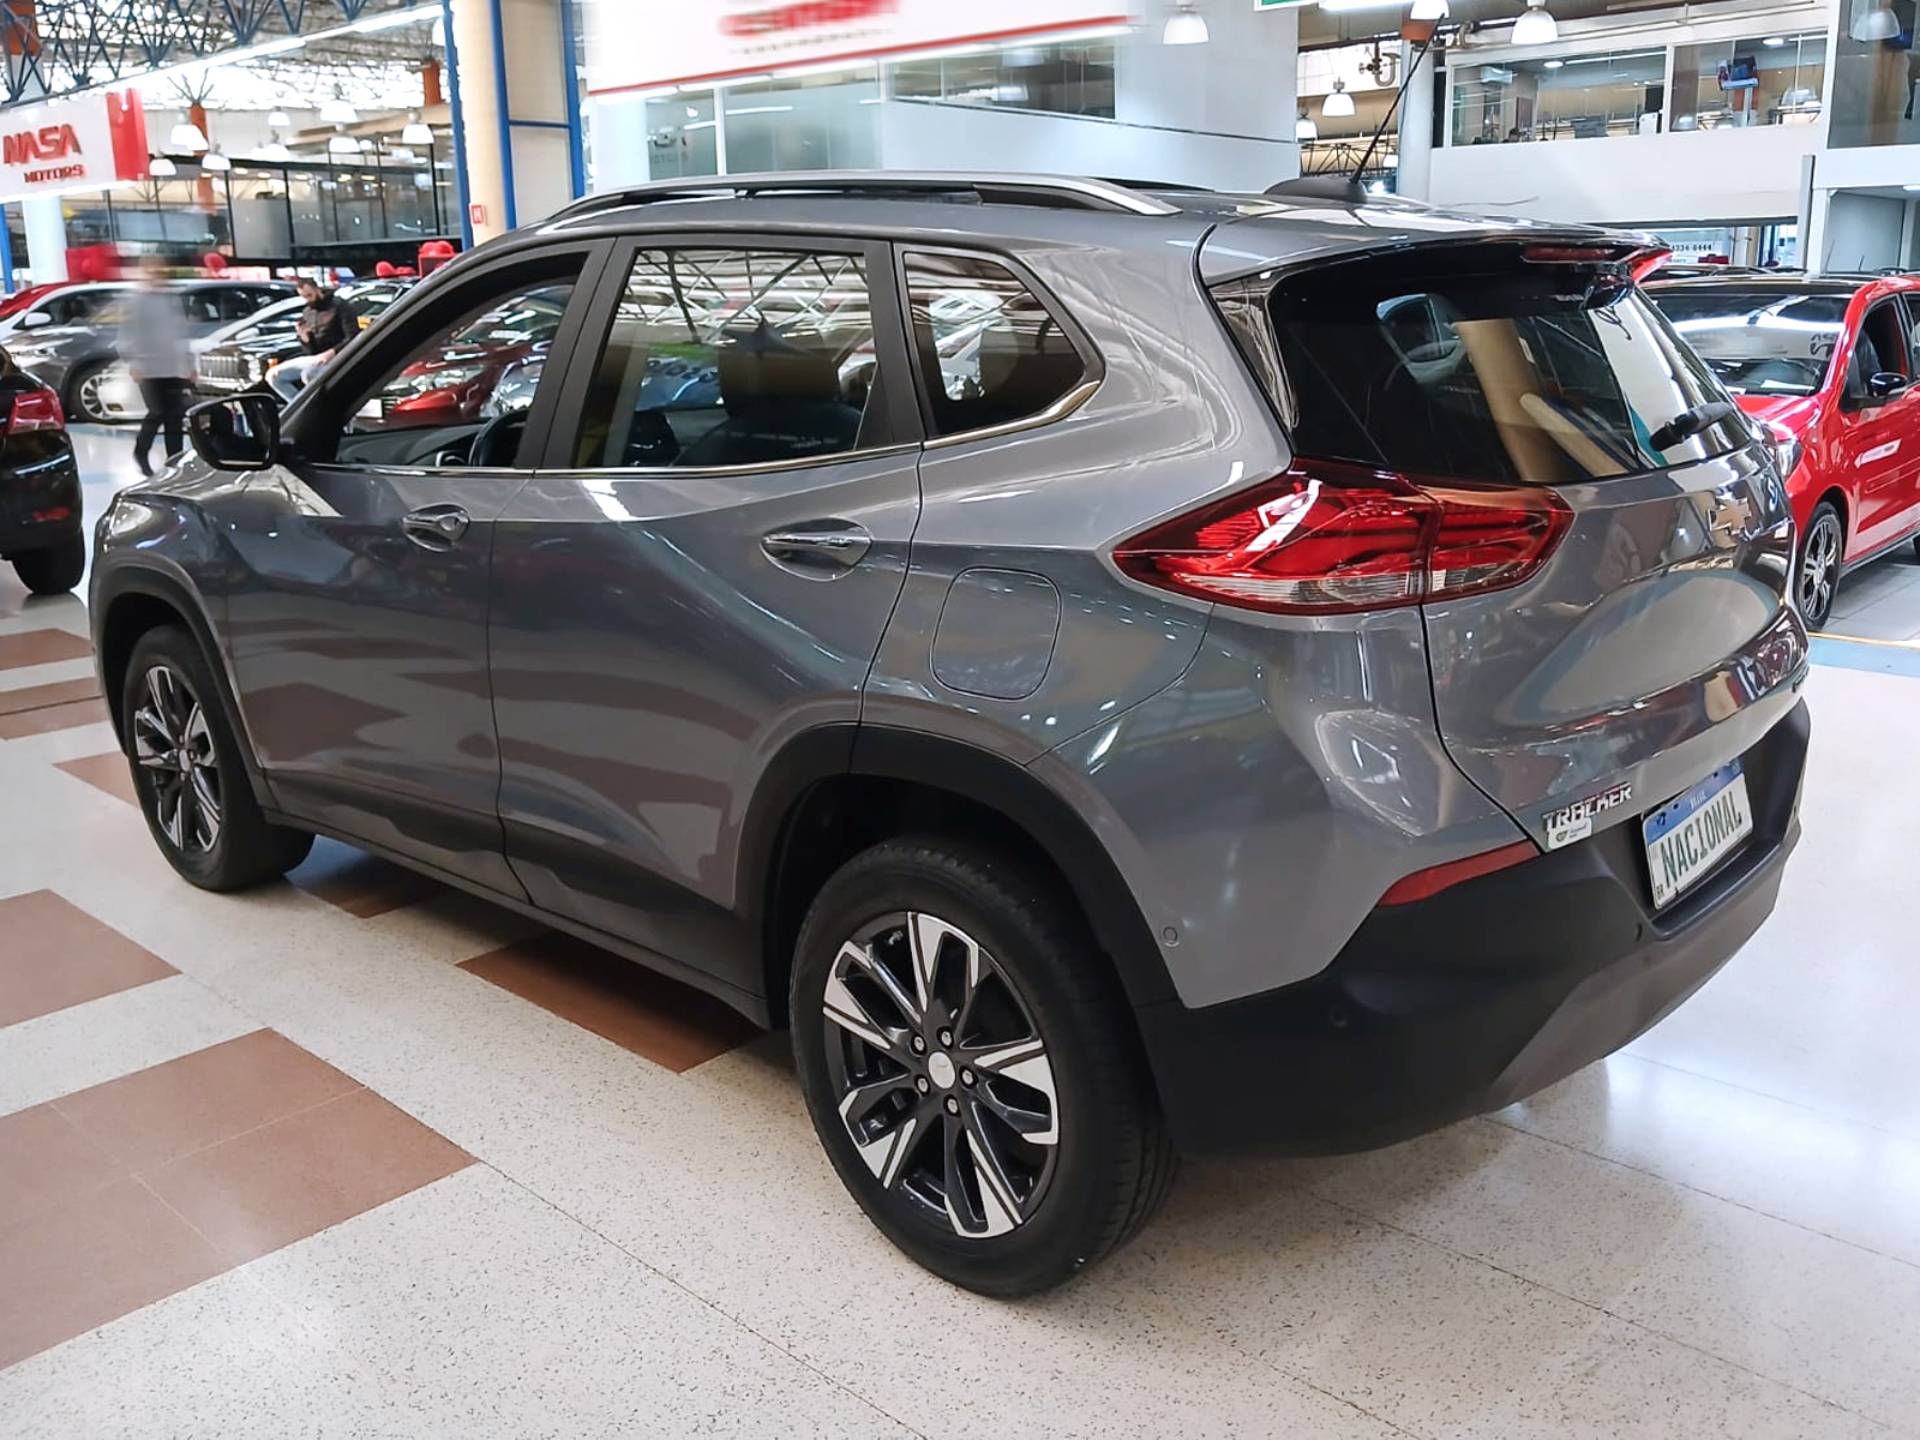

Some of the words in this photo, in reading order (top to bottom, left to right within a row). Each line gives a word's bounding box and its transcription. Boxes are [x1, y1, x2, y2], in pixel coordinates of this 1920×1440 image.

[3, 123, 82, 165] NASA
[24, 164, 84, 183] MOTORS
[1542, 782, 1632, 832] TRACKER
[1660, 791, 1742, 889] NACIONAL
